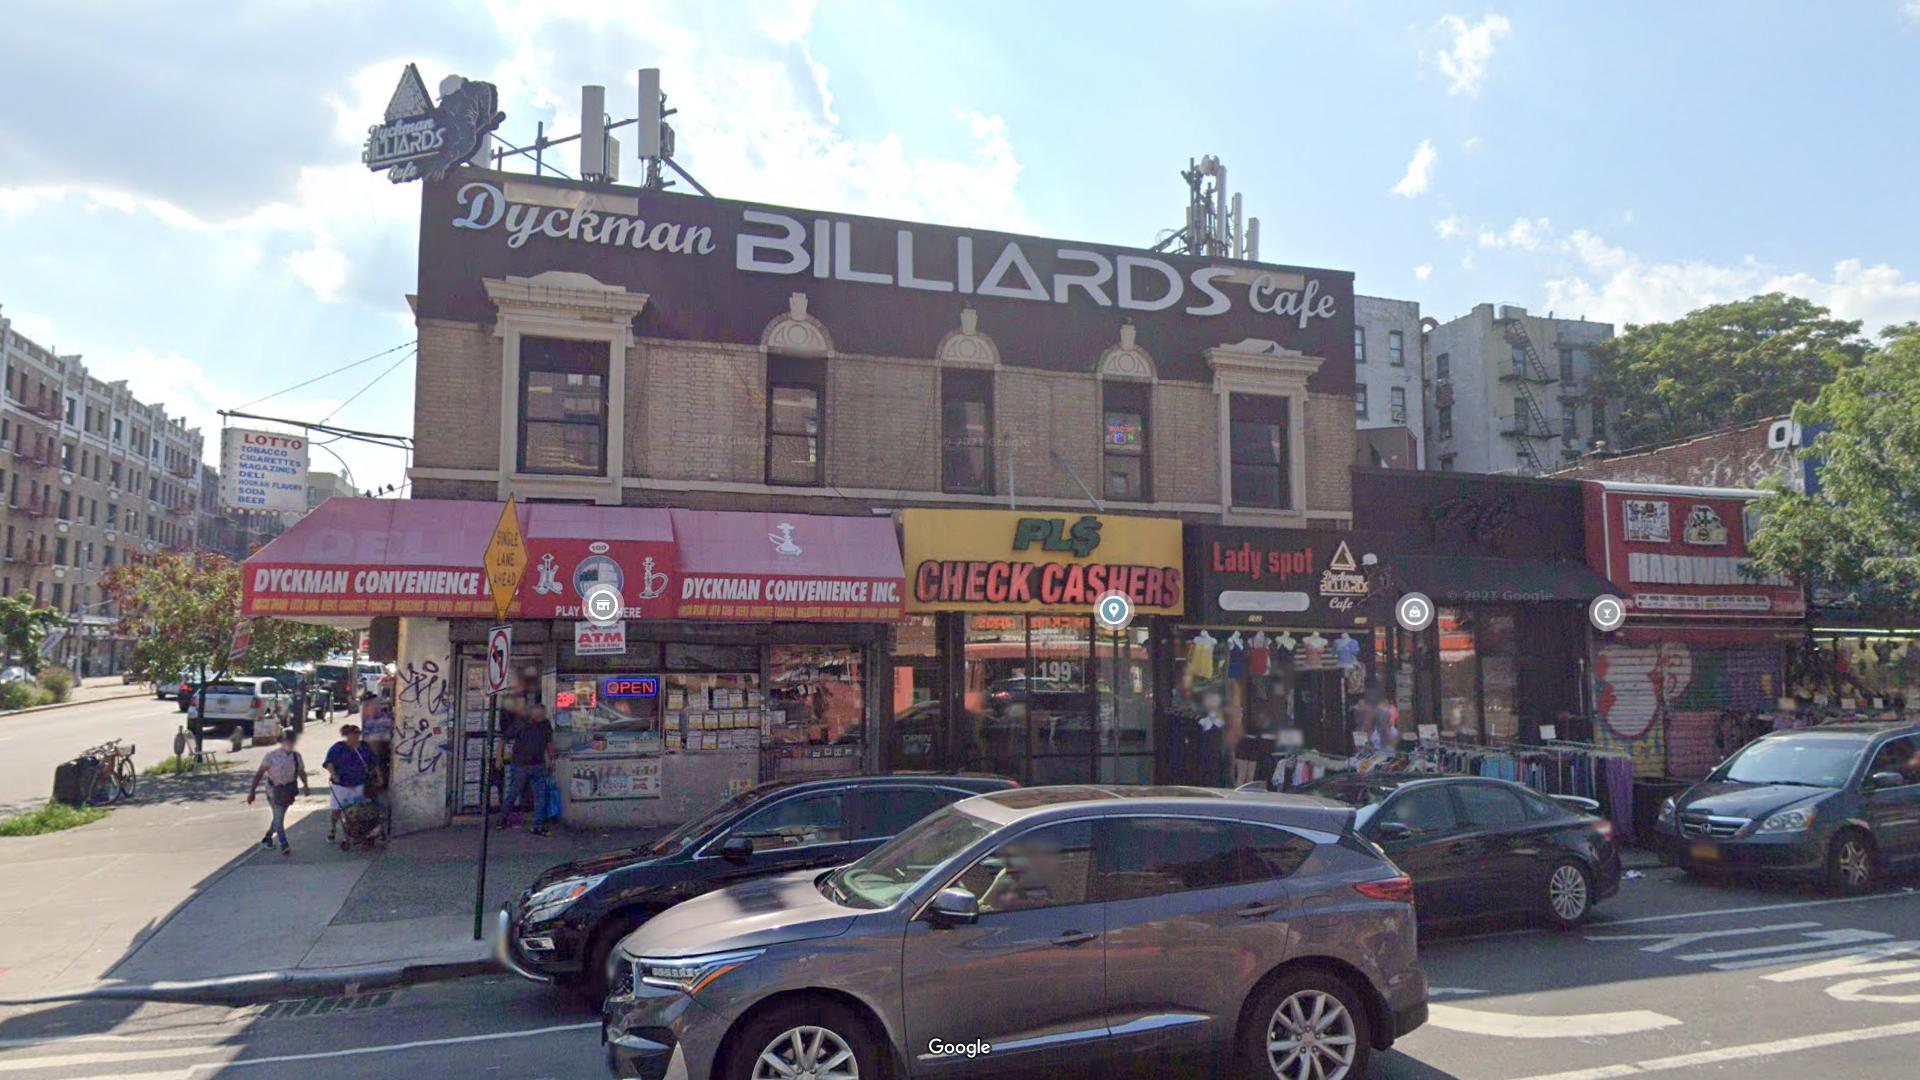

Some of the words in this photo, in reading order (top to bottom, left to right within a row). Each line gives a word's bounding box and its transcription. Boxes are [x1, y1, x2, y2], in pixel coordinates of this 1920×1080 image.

[366, 118, 434, 143] Dyckman
[451, 181, 716, 256] Dyckman
[736, 209, 1237, 318] BILLIARDS
[1248, 276, 1338, 328] Cafe
[244, 433, 302, 450] LOTTO
[241, 445, 288, 457] TOBACCO
[239, 453, 301, 467] CIGARETTES
[239, 462, 297, 474] MAGAZINES
[238, 487, 265, 496] SODA
[238, 496, 265, 505] BEER
[496, 531, 519, 547] SINGLE
[590, 542, 608, 552] 100
[496, 551, 515, 568] LANE
[1213, 542, 1262, 580] Lady
[1268, 547, 1314, 582] spot
[253, 567, 350, 593] DYCKMAN
[354, 570, 480, 595] CONVENIENCE
[494, 571, 517, 587] AHEAD
[914, 560, 1036, 603] CHECK
[1040, 562, 1181, 608] CASHERS
[682, 578, 761, 600] DYCKMAN
[765, 580, 867, 602] CONVENIENCE
[871, 582, 900, 602] INC.
[555, 606, 580, 617] PLAY
[616, 607, 641, 618] HERE
[1328, 597, 1353, 613] Cafe
[577, 632, 623, 644] ATM
[1040, 661, 1072, 681] 199
[607, 681, 654, 694] OPEN
